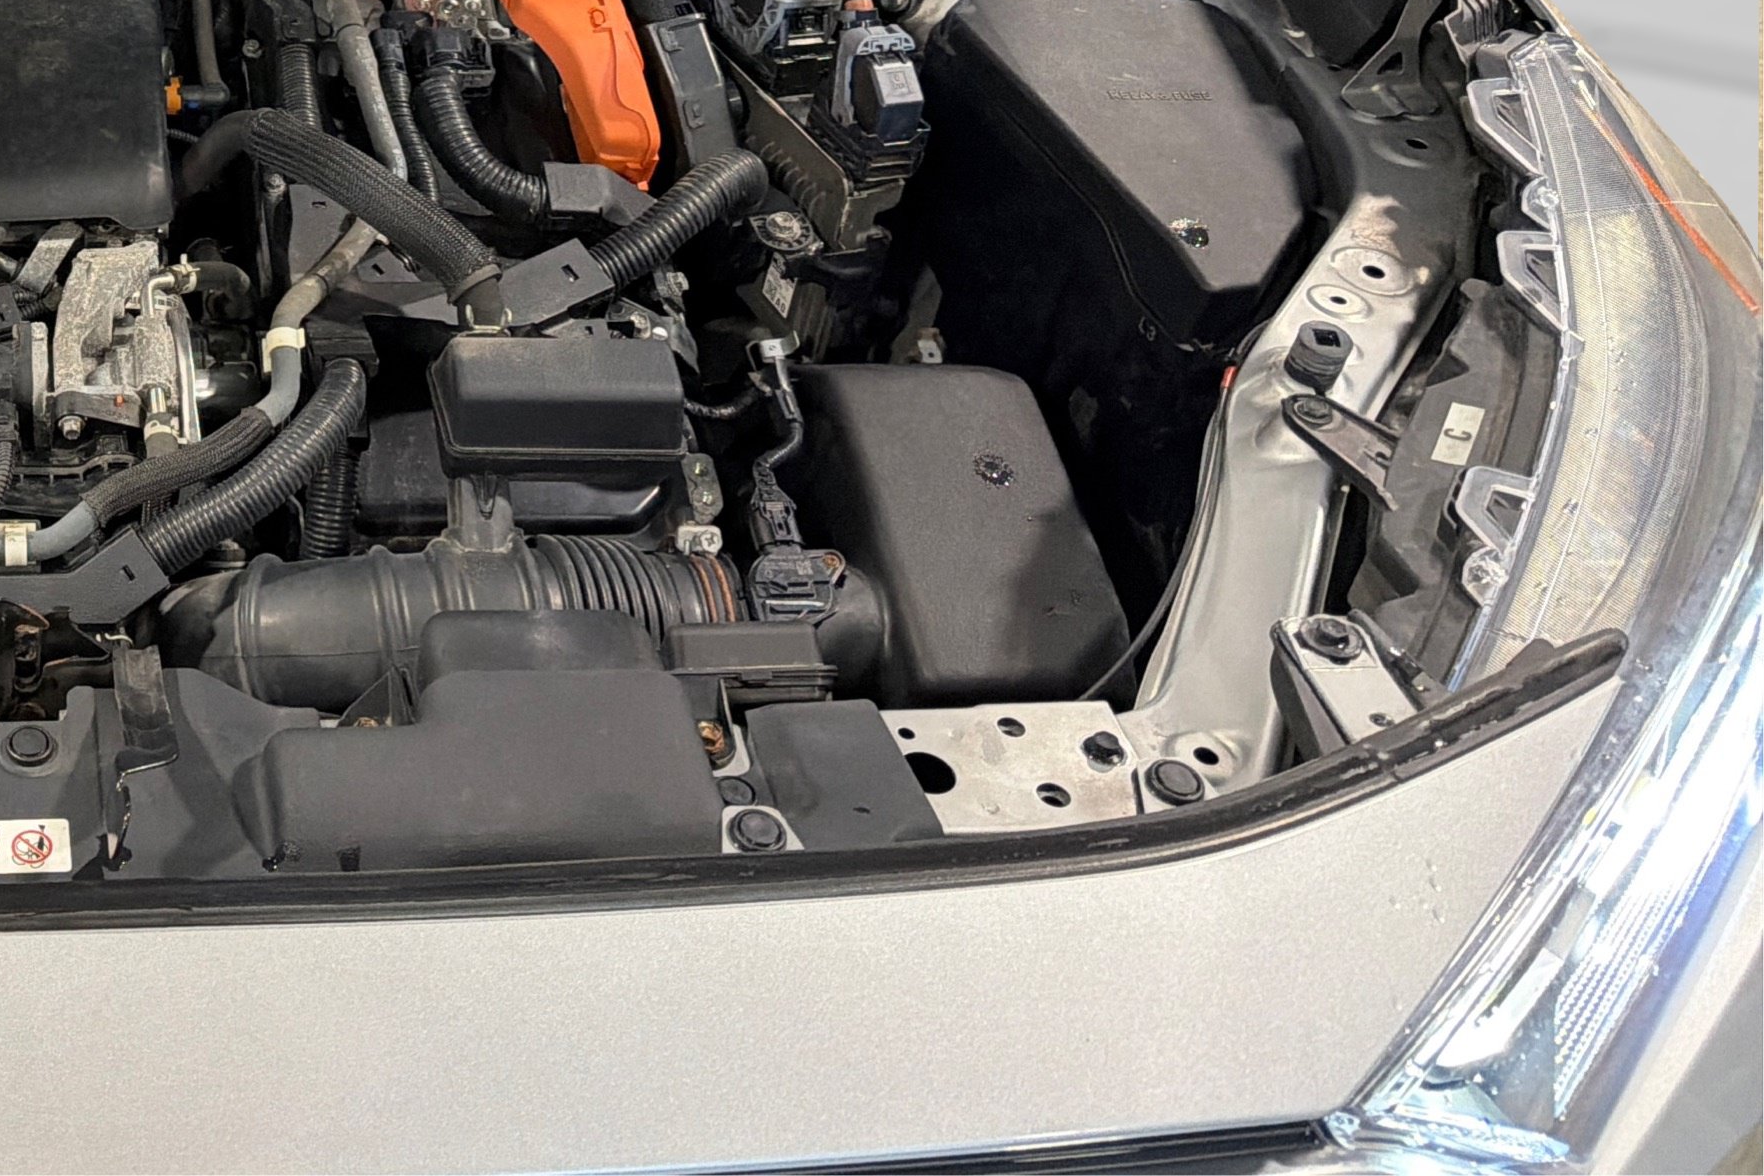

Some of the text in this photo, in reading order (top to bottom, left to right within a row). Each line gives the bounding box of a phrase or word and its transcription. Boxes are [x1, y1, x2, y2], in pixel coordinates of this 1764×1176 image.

[1106, 90, 1156, 101] RELAY
[1172, 91, 1212, 101] FUSE
[1443, 428, 1472, 441] C
